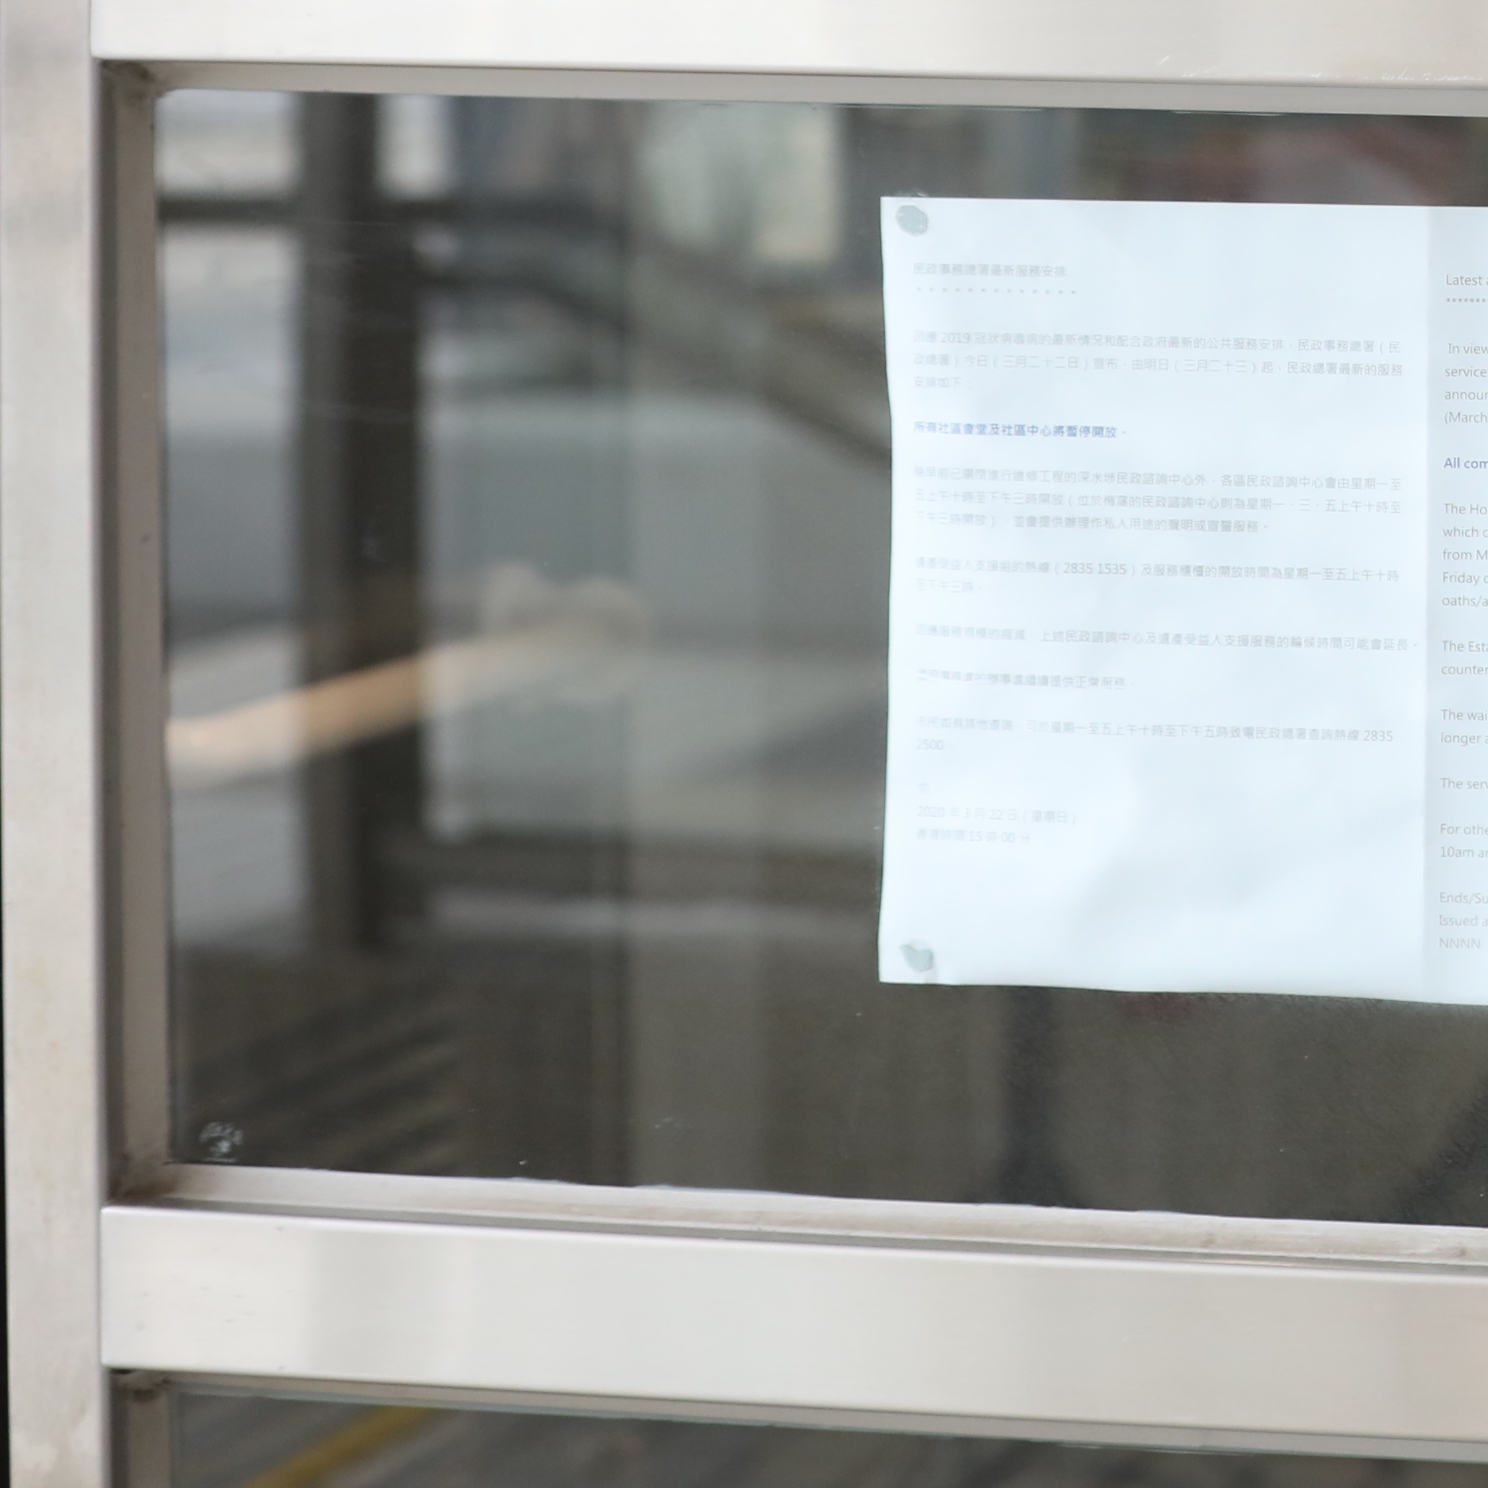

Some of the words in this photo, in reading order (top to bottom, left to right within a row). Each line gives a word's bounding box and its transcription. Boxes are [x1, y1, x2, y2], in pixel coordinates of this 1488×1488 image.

[1446, 274, 1483, 286] Latest
[1445, 365, 1487, 378] service
[1444, 457, 1460, 469] All
[1443, 502, 1466, 515] The
[1442, 639, 1464, 652] The
[1440, 776, 1463, 790] The
